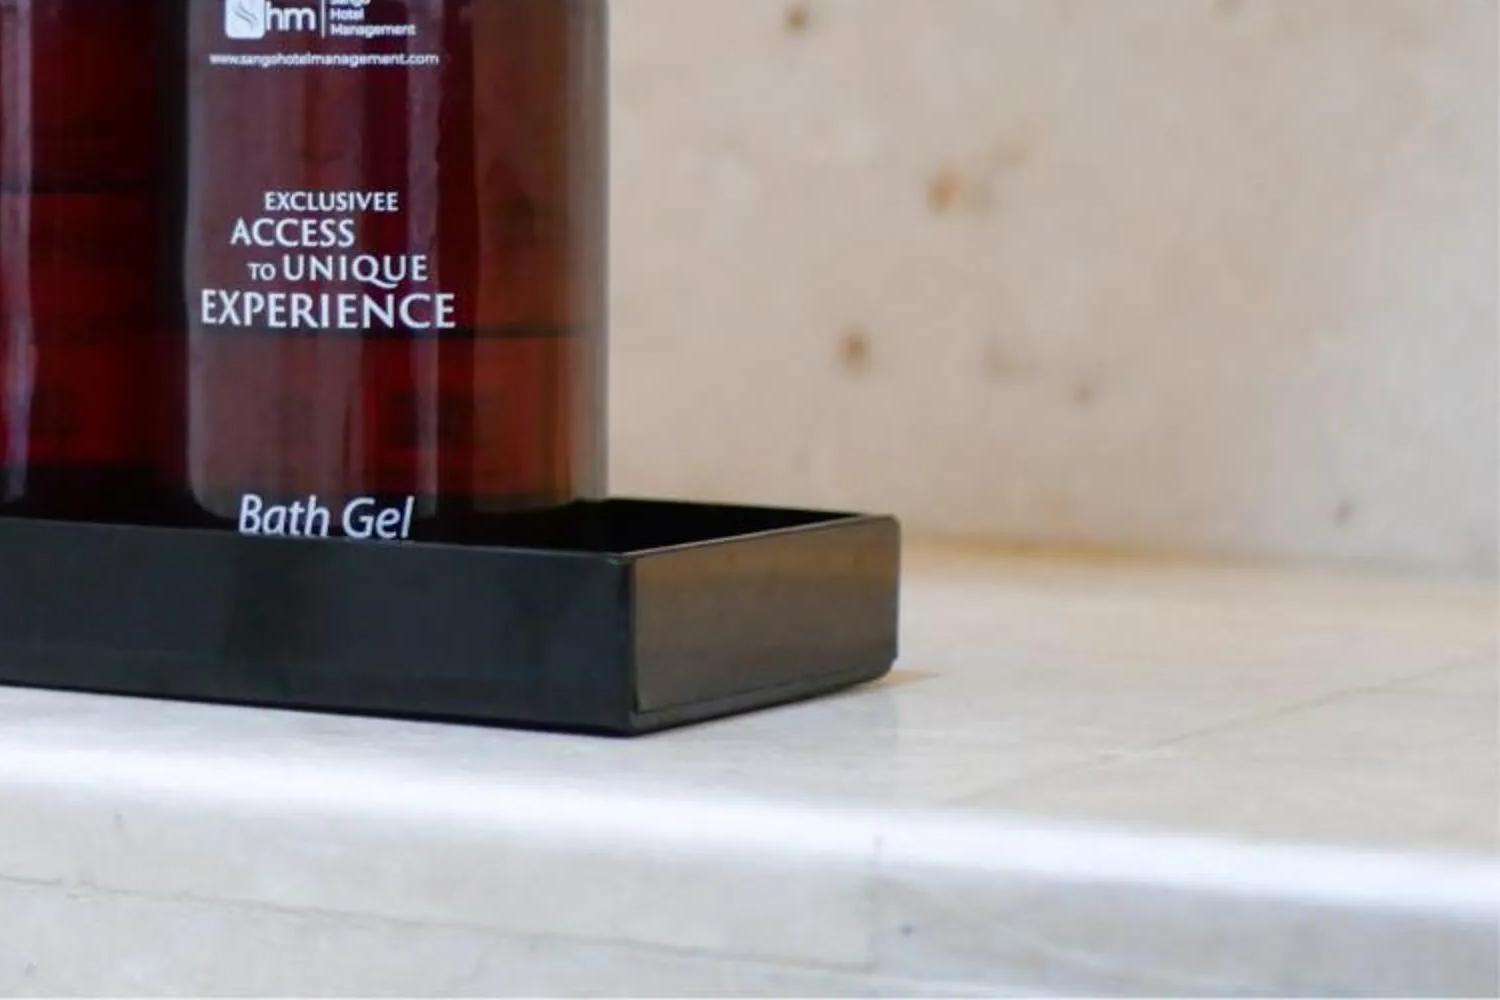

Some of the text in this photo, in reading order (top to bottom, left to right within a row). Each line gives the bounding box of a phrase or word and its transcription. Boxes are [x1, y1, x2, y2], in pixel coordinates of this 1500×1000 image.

[329, 8, 366, 21] Hotel
[329, 23, 417, 39] Management
[208, 52, 441, 69] www.sangohotelmanagement.com
[263, 190, 399, 213] EXCLUSIVEE
[230, 216, 356, 248] ACCESS
[248, 253, 429, 290] TO UNIQUE
[200, 288, 457, 330] EXPERIENCE
[238, 493, 416, 540] Bath Gel
